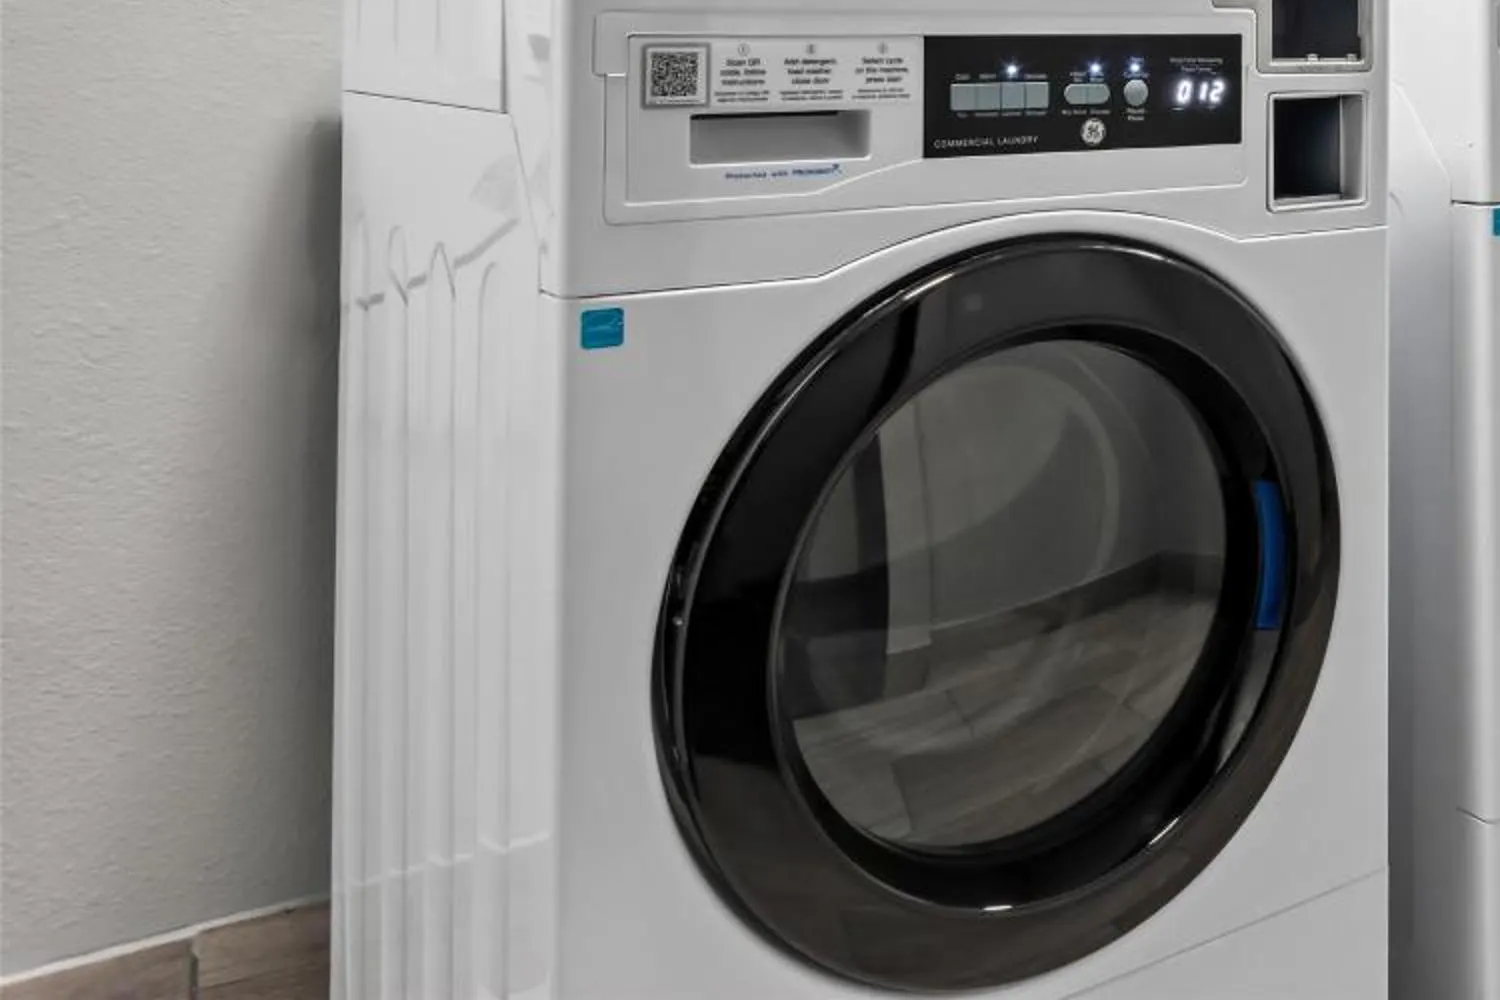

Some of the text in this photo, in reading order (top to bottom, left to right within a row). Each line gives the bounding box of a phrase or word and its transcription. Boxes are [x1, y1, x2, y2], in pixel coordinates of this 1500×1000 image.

[1176, 79, 1225, 104] 012
[933, 134, 1039, 149] COMMERCIAL LAUNDRY
